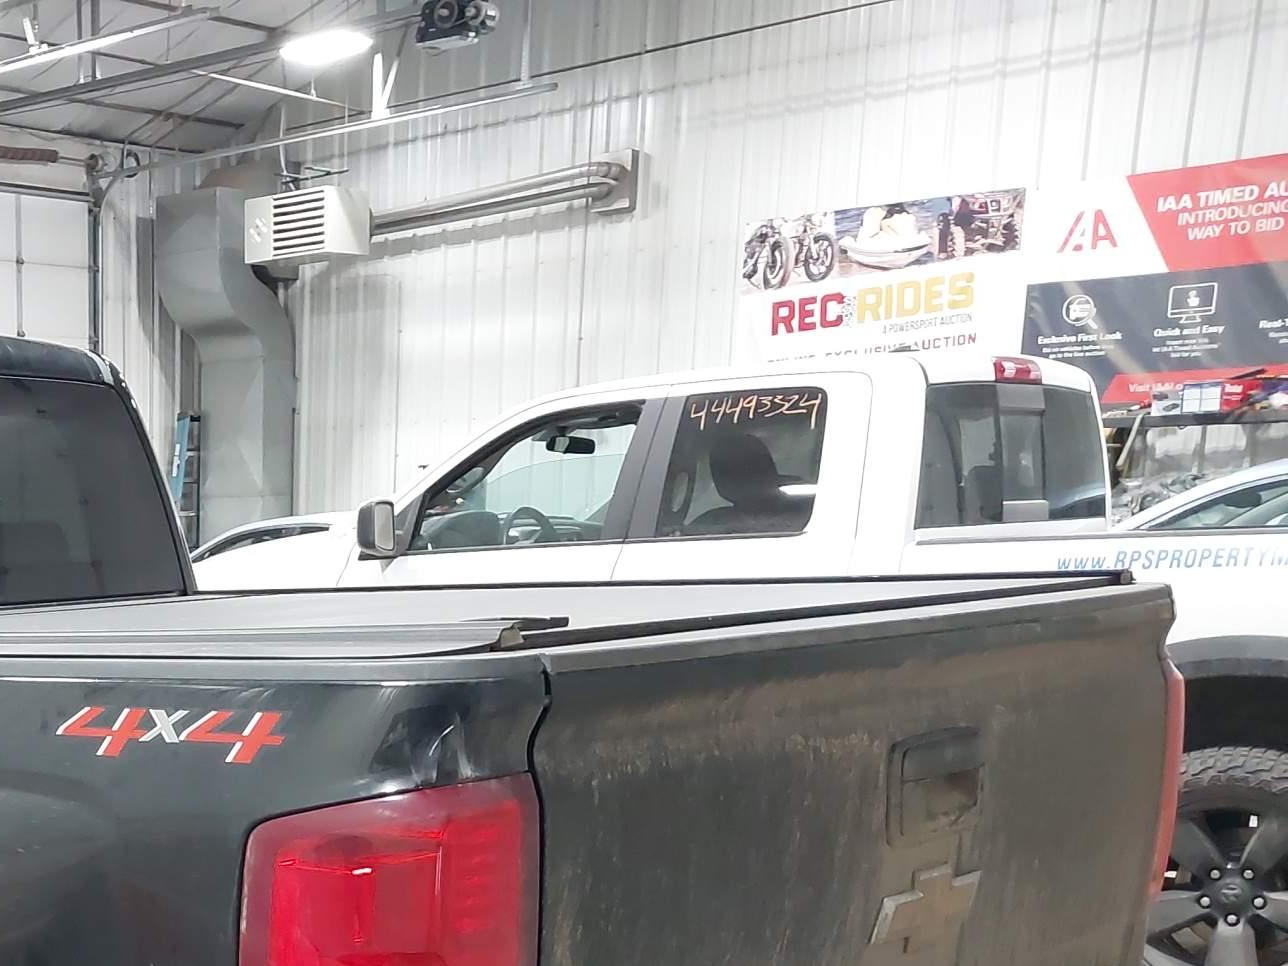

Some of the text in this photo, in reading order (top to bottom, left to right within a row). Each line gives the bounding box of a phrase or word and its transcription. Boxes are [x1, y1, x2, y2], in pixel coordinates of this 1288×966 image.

[1157, 193, 1193, 212] IAA
[1197, 185, 1260, 208] TIMED
[1187, 217, 1285, 241] WAY TO BID
[771, 272, 976, 337] REC RIDES
[1202, 324, 1225, 335] Easy
